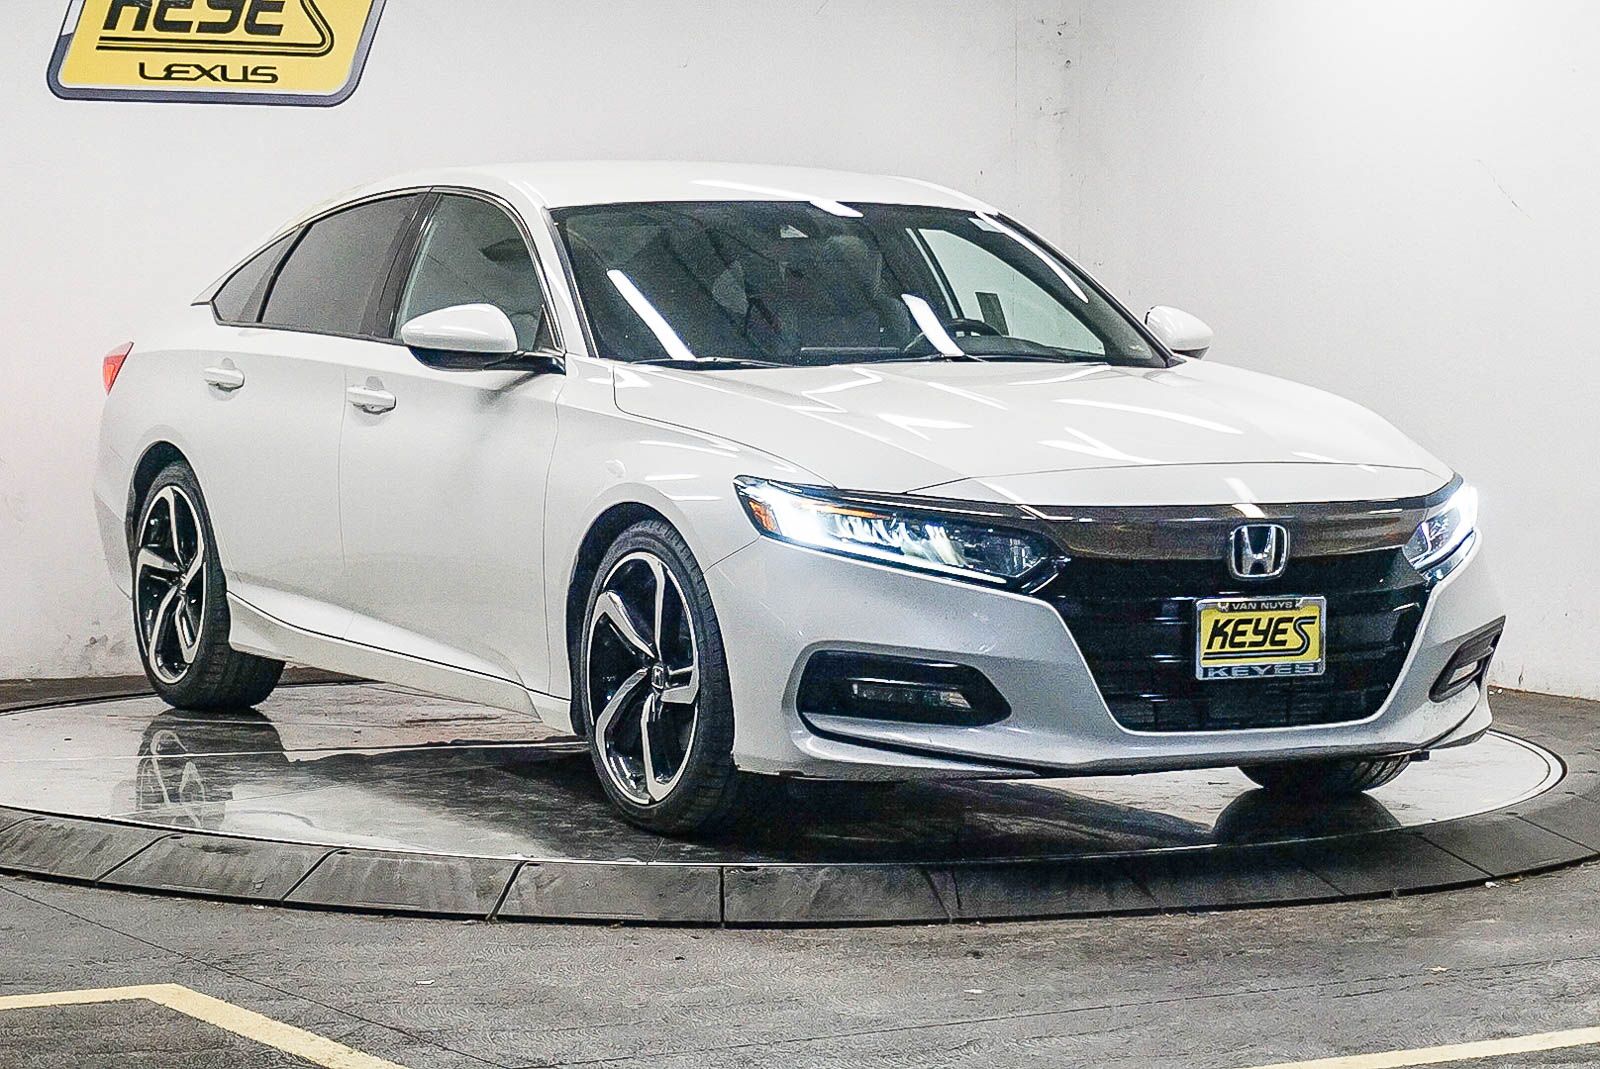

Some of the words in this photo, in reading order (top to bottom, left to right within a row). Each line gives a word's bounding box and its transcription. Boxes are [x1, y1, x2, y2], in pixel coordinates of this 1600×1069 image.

[138, 62, 279, 83] LEXUS
[1232, 602, 1257, 610] VAN
[1260, 601, 1293, 610] NUYS
[1202, 616, 1317, 660] KEYES
[1207, 664, 1314, 677] KEYES
